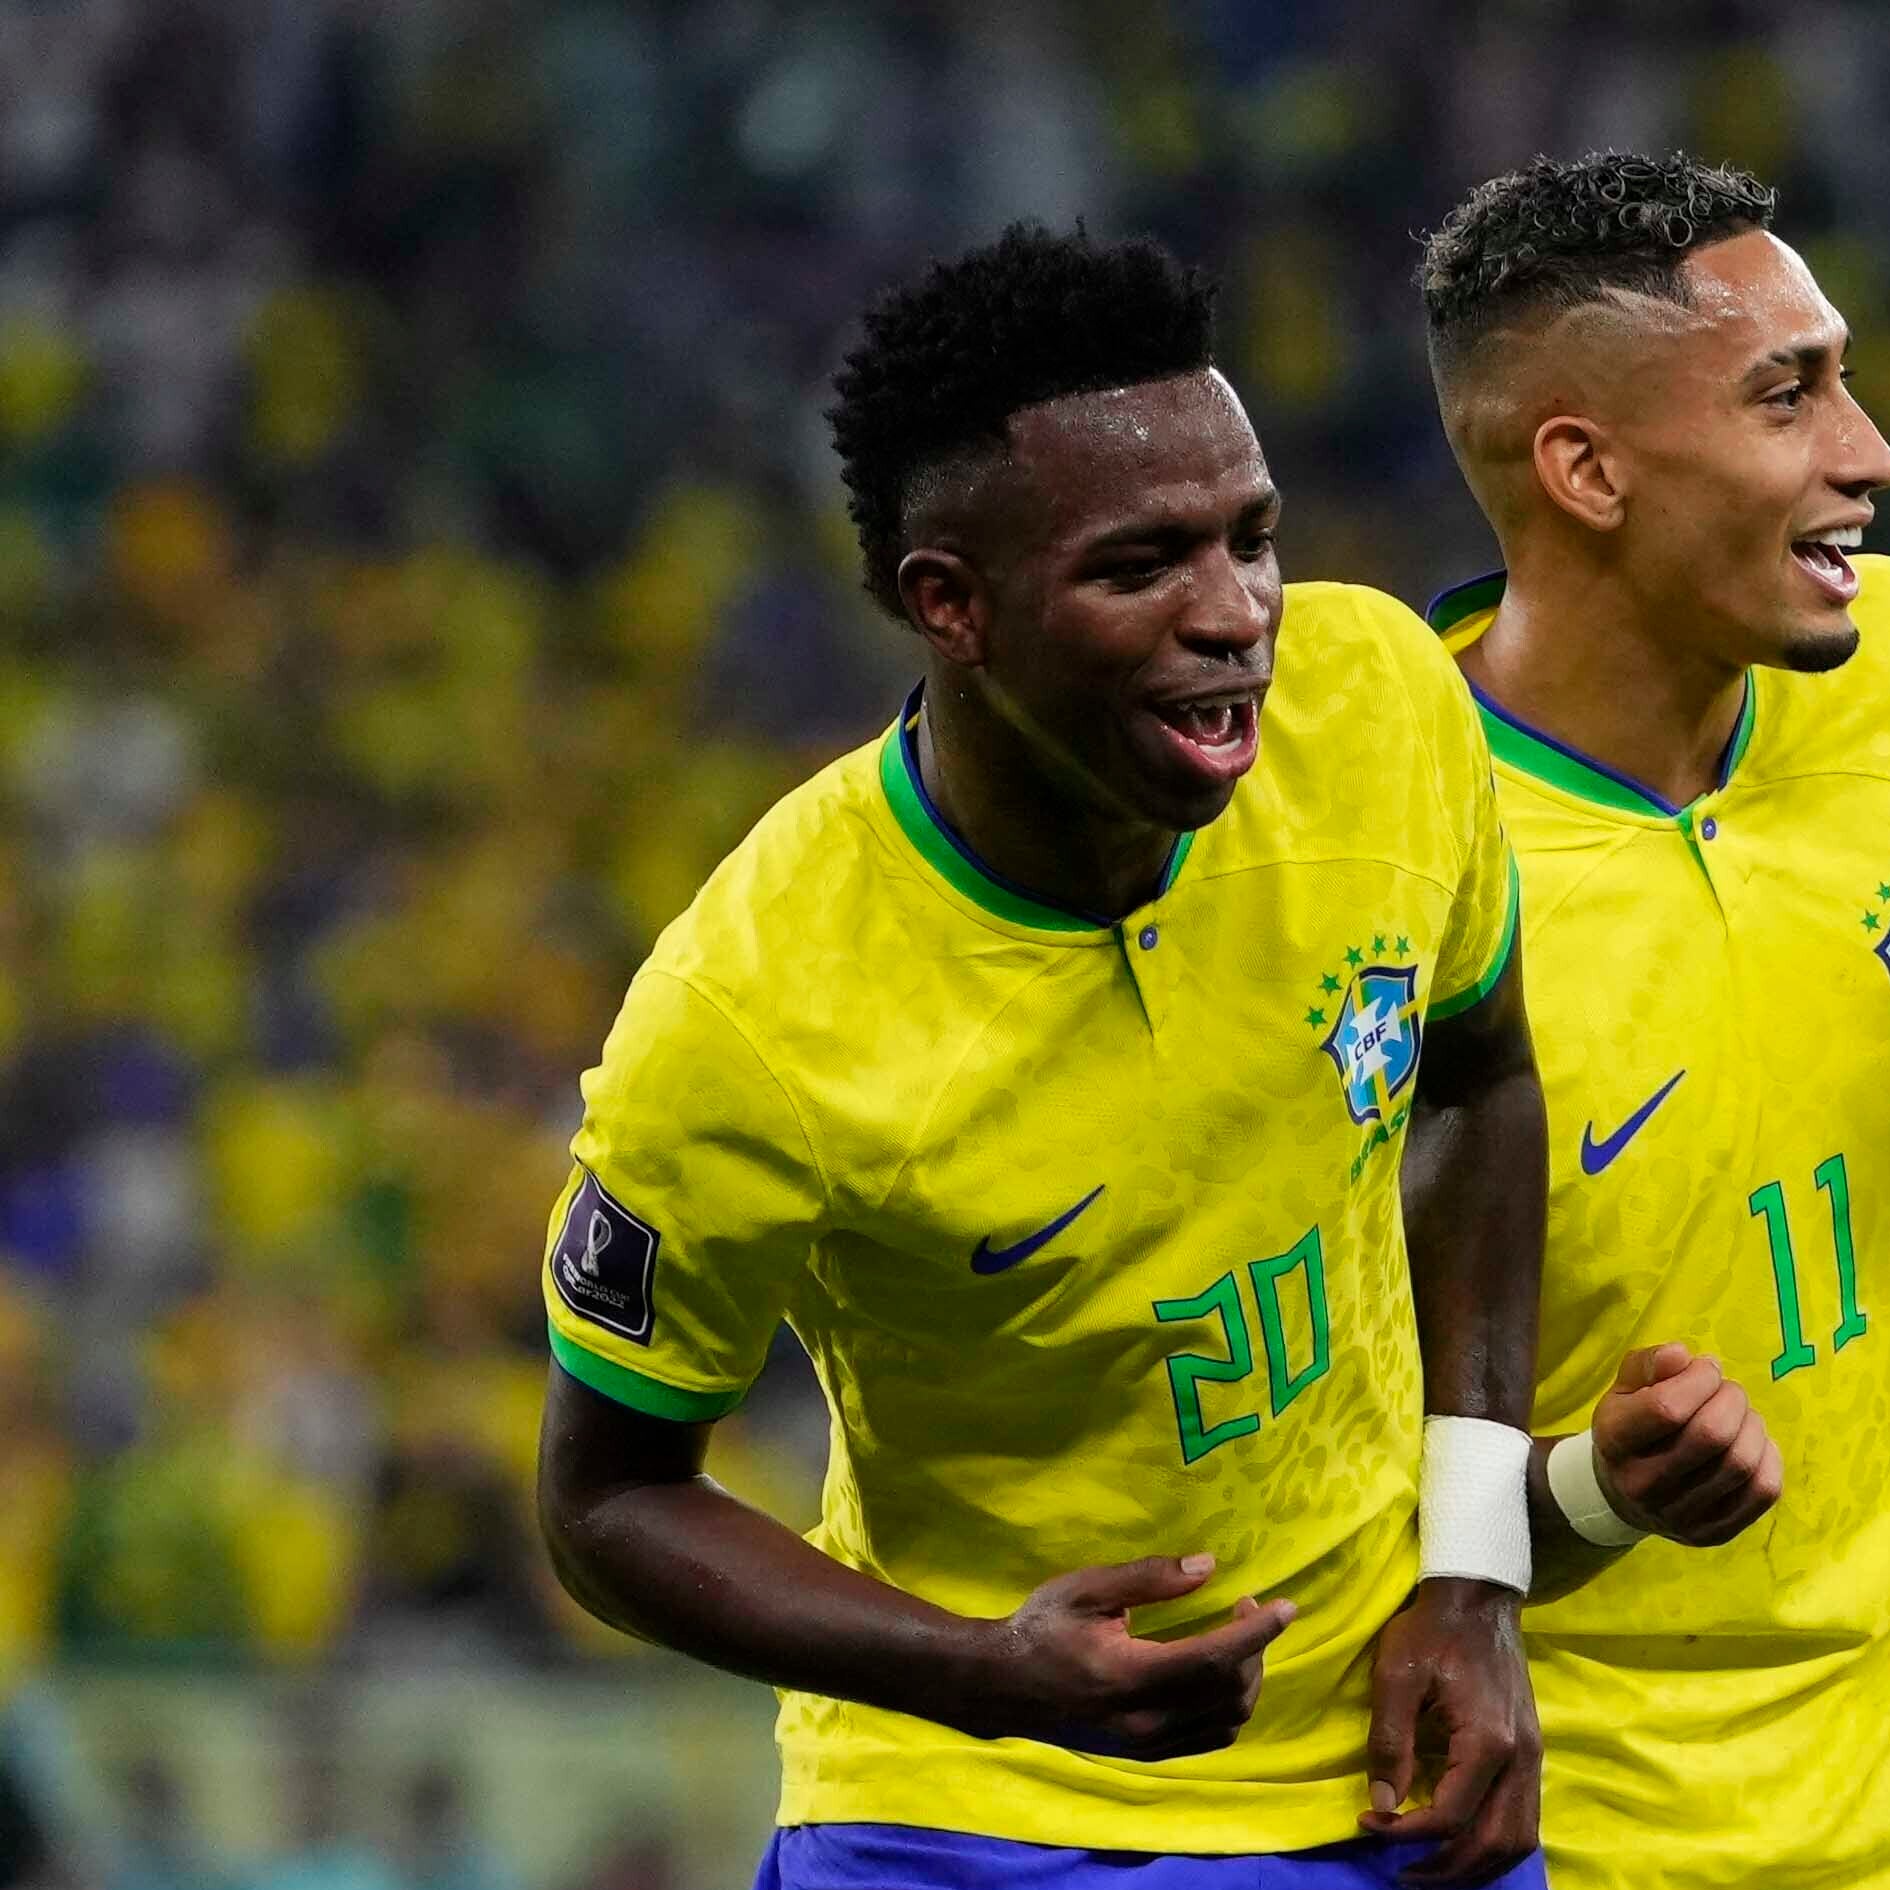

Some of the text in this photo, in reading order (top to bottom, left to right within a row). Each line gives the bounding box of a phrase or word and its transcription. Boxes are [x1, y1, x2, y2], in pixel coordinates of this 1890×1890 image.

[1354, 1021, 1387, 1061] CBF
[1151, 1223, 1330, 1466] 20
[1748, 1153, 1867, 1381] 11
